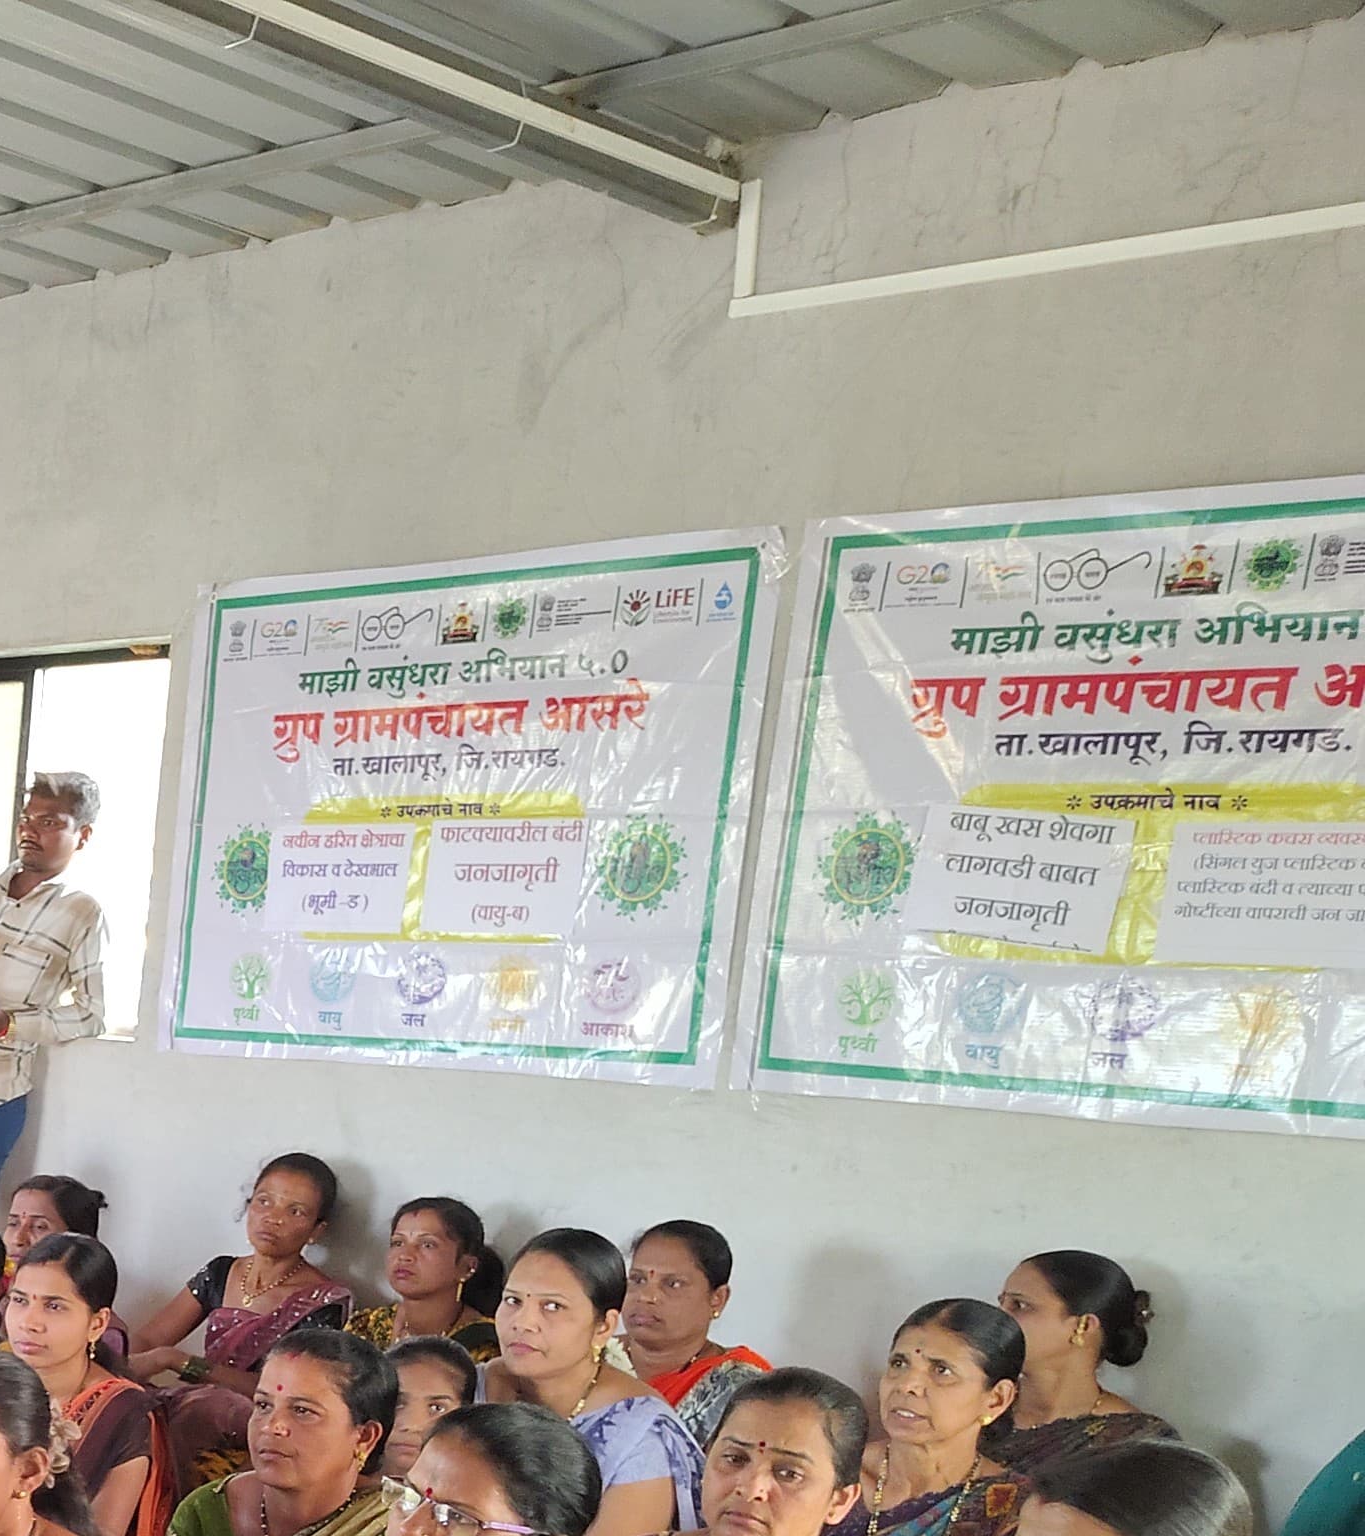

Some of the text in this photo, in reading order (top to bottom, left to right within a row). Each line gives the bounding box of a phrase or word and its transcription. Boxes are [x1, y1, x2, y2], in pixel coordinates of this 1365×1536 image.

[655, 587, 694, 608] LiFE
[951, 611, 1045, 655] माझी
[1054, 608, 1181, 664] वसुंधरा
[298, 657, 361, 696] माझी
[367, 655, 452, 699] वसुंधरा
[459, 649, 568, 685] अभियान
[998, 654, 1300, 721] ग्रामपंचायत
[273, 677, 650, 764] ग्रुप ग्रामपंचायत आसरे
[458, 802, 484, 817] नाव
[1089, 788, 1222, 811] उपक्रमाचे नाव
[324, 829, 358, 848] हरित
[1049, 815, 1117, 845] शेवगा
[282, 858, 399, 878] विकास व देखभाल
[454, 857, 561, 892] जनजागृती
[945, 852, 1101, 886] लागवडी बाबत
[954, 895, 1072, 932] जनजागृती
[401, 1012, 427, 1028] जल
